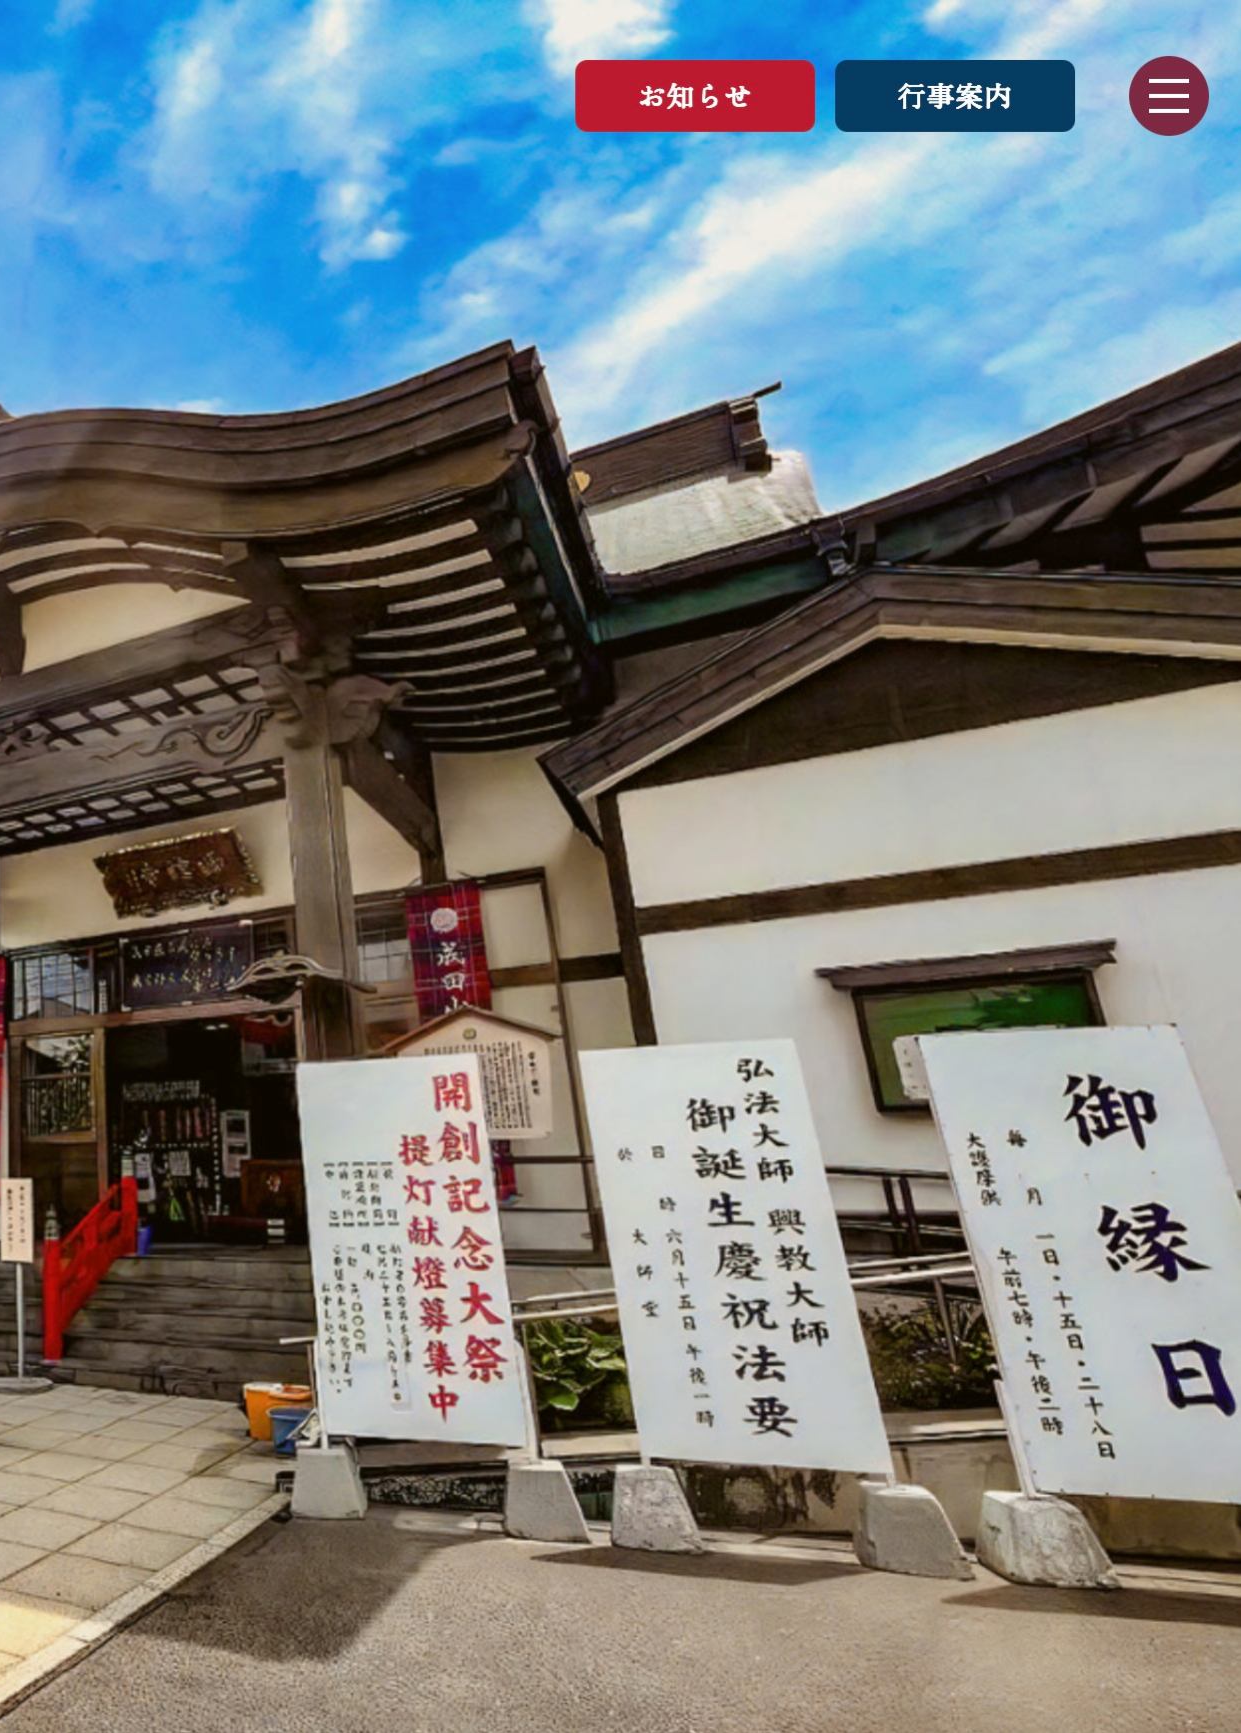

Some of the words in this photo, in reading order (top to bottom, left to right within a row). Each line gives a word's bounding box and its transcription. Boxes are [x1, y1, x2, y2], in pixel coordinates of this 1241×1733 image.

[398, 1134, 459, 1423] 提灯献燈募集中
[431, 1072, 508, 1384] 開創記念大祭
[686, 1097, 798, 1438] 御誕生慶祝法要
[736, 1058, 796, 1183] 弘法大師
[767, 1208, 830, 1348] 興教大師
[1063, 1073, 1238, 1418] 御縁日
